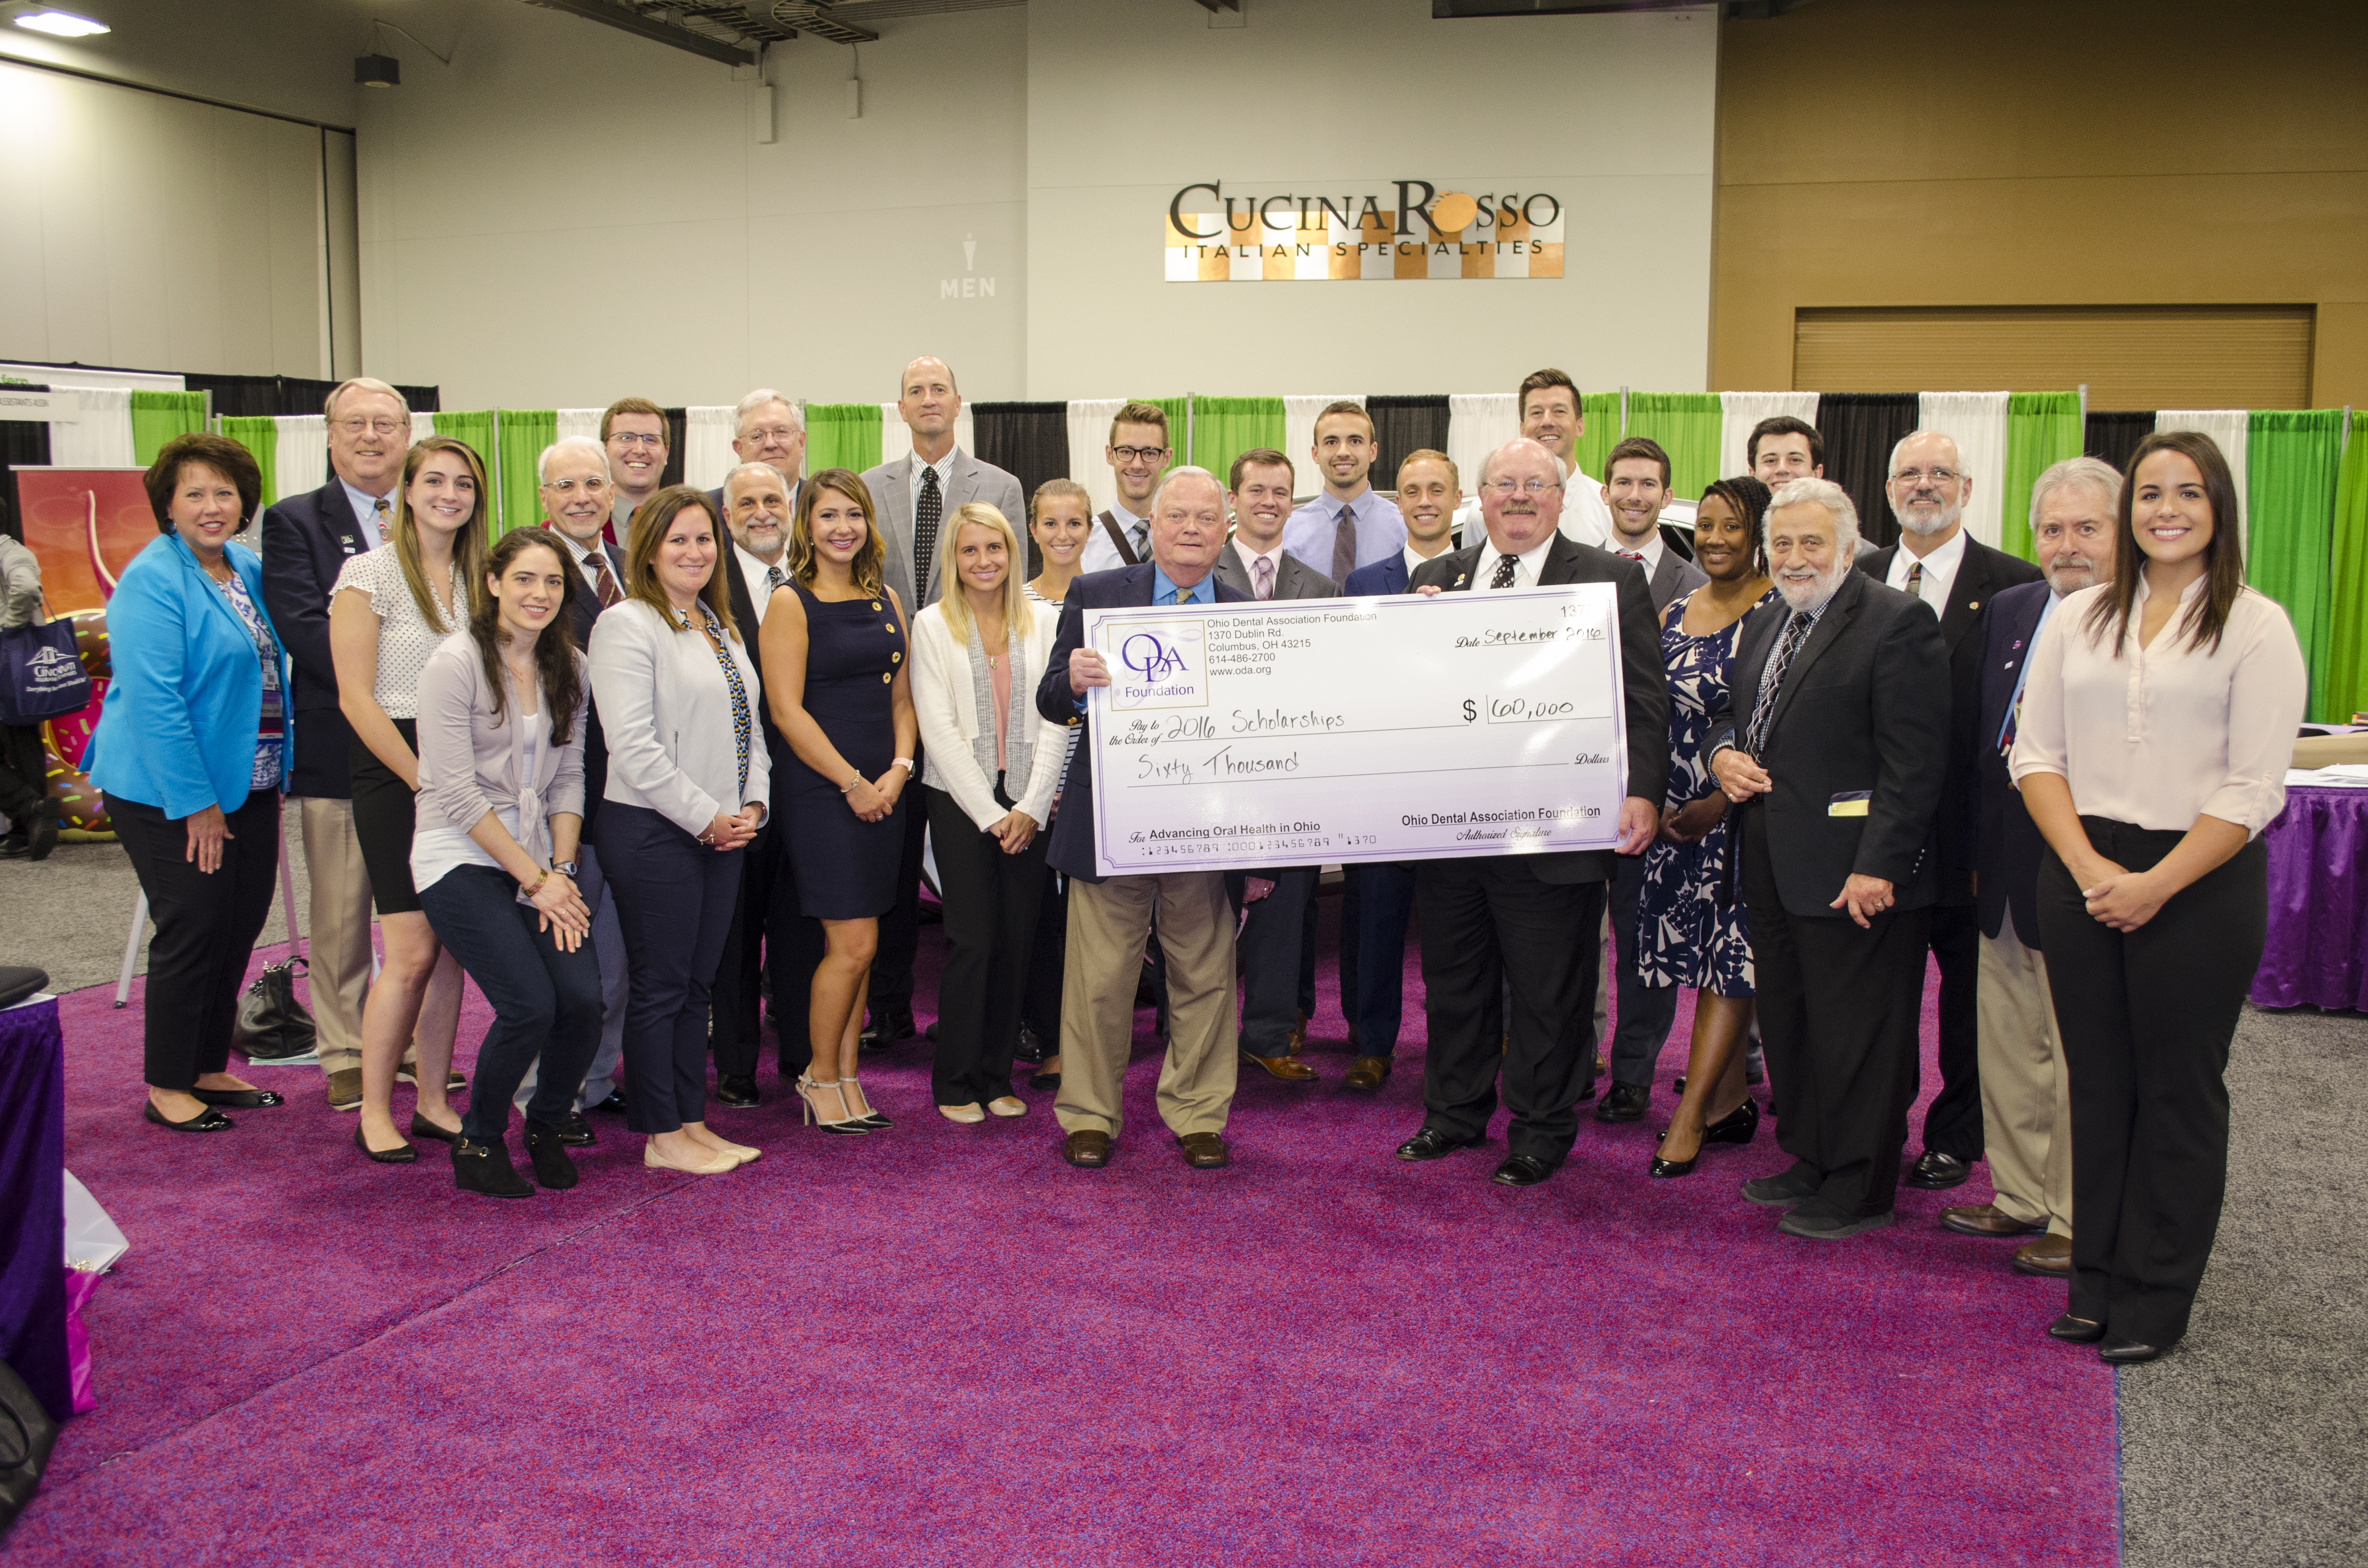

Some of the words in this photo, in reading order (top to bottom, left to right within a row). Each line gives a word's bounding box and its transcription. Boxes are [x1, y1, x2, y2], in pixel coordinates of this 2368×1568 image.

[1184, 243, 1311, 258] ITALIAN
[1336, 239, 1544, 256] SPECIALTIES
[940, 277, 995, 299] MEN
[1208, 619, 1230, 628] Ohio
[1233, 617, 1263, 627] Dental
[1266, 615, 1320, 625] Association
[1324, 612, 1377, 624] Foundation
[1209, 630, 1231, 639] 1370
[1234, 629, 1264, 639] Dublin
[1268, 628, 1284, 637] Rd.
[1484, 627, 1558, 645] September
[1209, 641, 1259, 652] Columbus,
[1263, 640, 1278, 649] OH
[1281, 639, 1311, 649] 43215
[1455, 637, 1480, 648] Date
[1122, 634, 1189, 682] ODA
[1209, 652, 1275, 664] 614-486-2700
[1209, 665, 1271, 676] www.oda.org
[1125, 685, 1194, 698] Foundation
[1463, 698, 1477, 723] $
[1492, 698, 1574, 720] 60,000
[1129, 720, 1148, 734] Pay
[1150, 720, 1159, 730] to
[1166, 715, 1216, 739] 2016
[1232, 709, 1344, 733] Scholarships
[1109, 735, 1122, 746] the
[1124, 733, 1148, 745] Order
[1150, 733, 1163, 747] of
[1138, 754, 1194, 785] Sixty
[1202, 745, 1299, 776] Thousand
[1574, 752, 1610, 765] Dollars
[1402, 815, 1428, 826] Ohio
[1431, 812, 1467, 824] Dental
[1470, 809, 1535, 822] Association
[1539, 806, 1601, 819] Foundation
[1129, 831, 1147, 844] For
[1150, 827, 1210, 840] Advancing
[1213, 825, 1237, 835] Oral
[1240, 823, 1276, 834] Health
[1280, 822, 1290, 833] in
[1294, 821, 1321, 832] Ohio
[1456, 829, 1508, 841] Authorized
[1510, 826, 1552, 840] Signature
